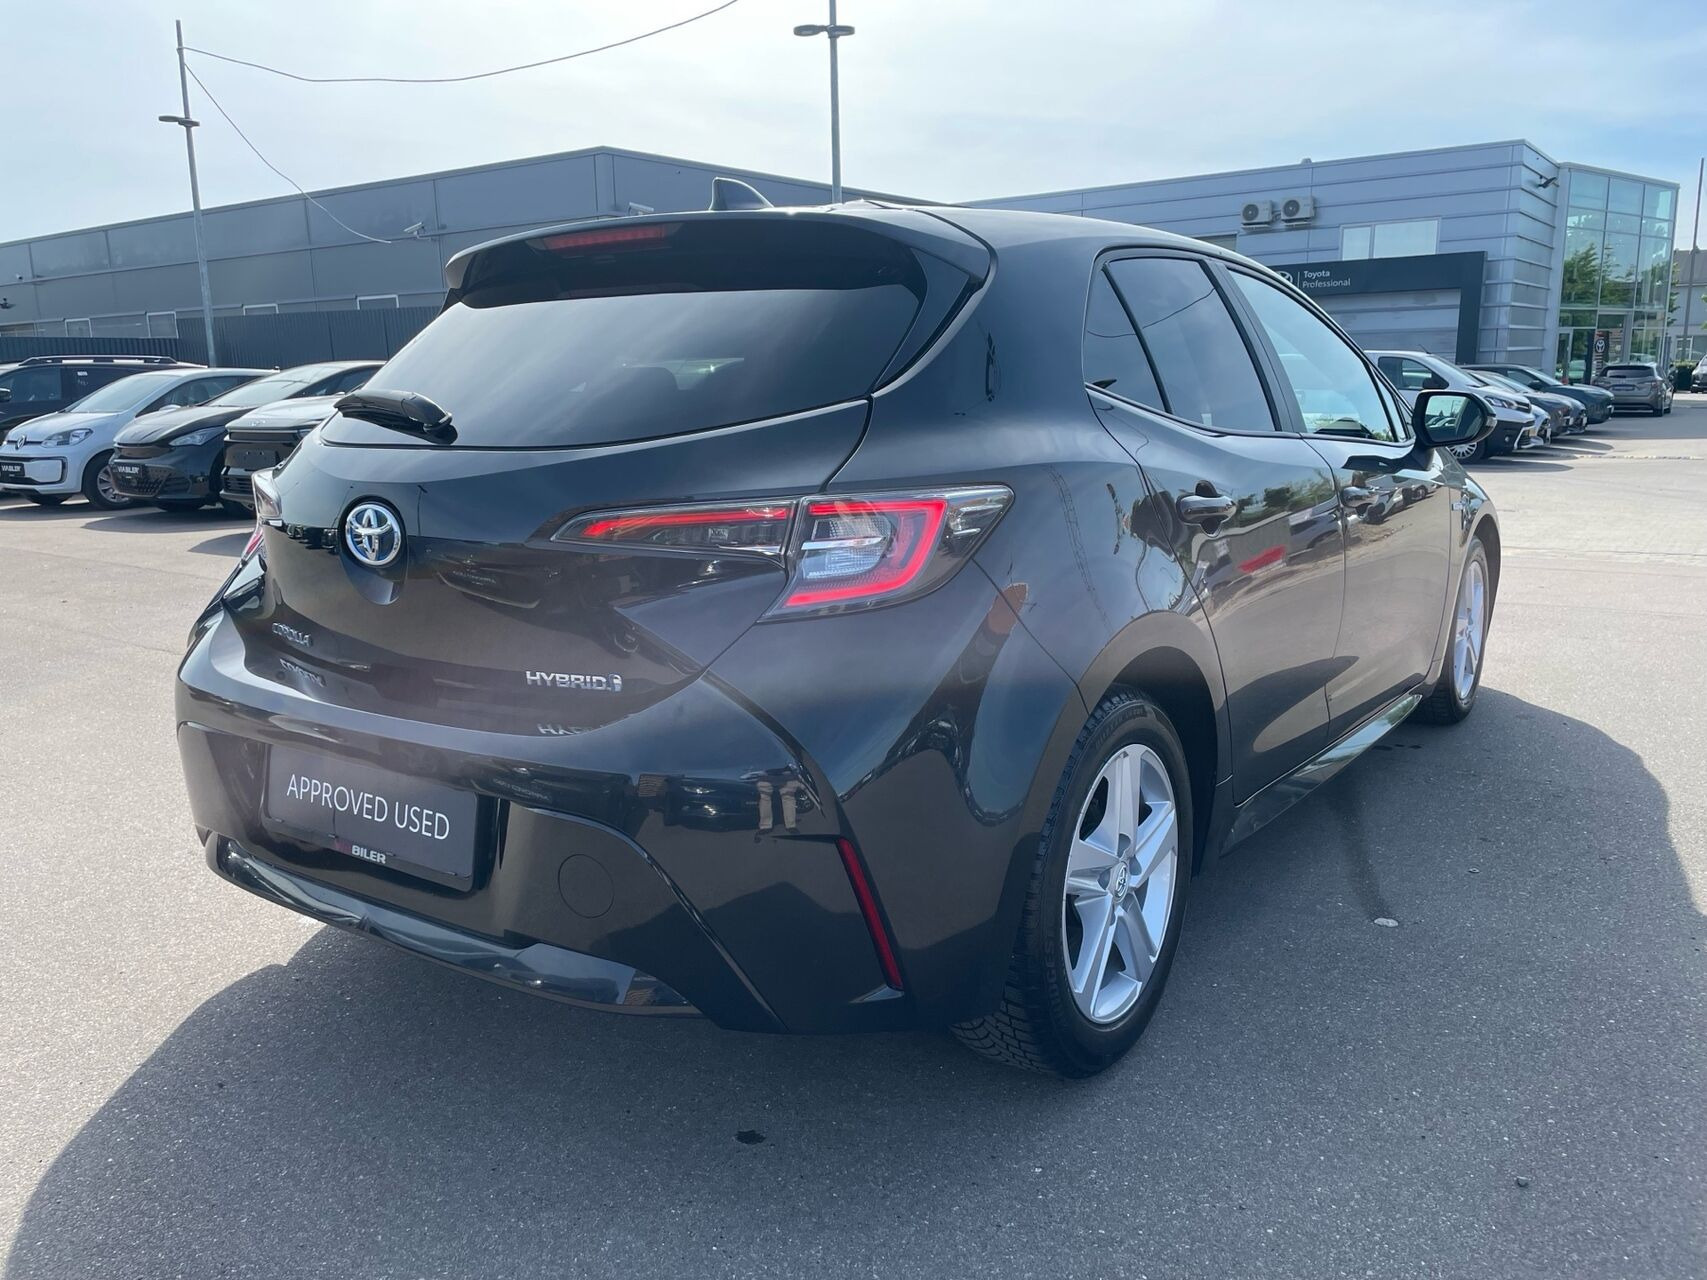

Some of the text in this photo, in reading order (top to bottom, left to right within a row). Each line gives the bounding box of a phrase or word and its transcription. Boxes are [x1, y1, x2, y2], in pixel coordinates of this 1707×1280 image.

[1304, 270, 1330, 279] Toyota
[1303, 278, 1351, 288] Professional
[287, 773, 450, 840] APPROVED USED
